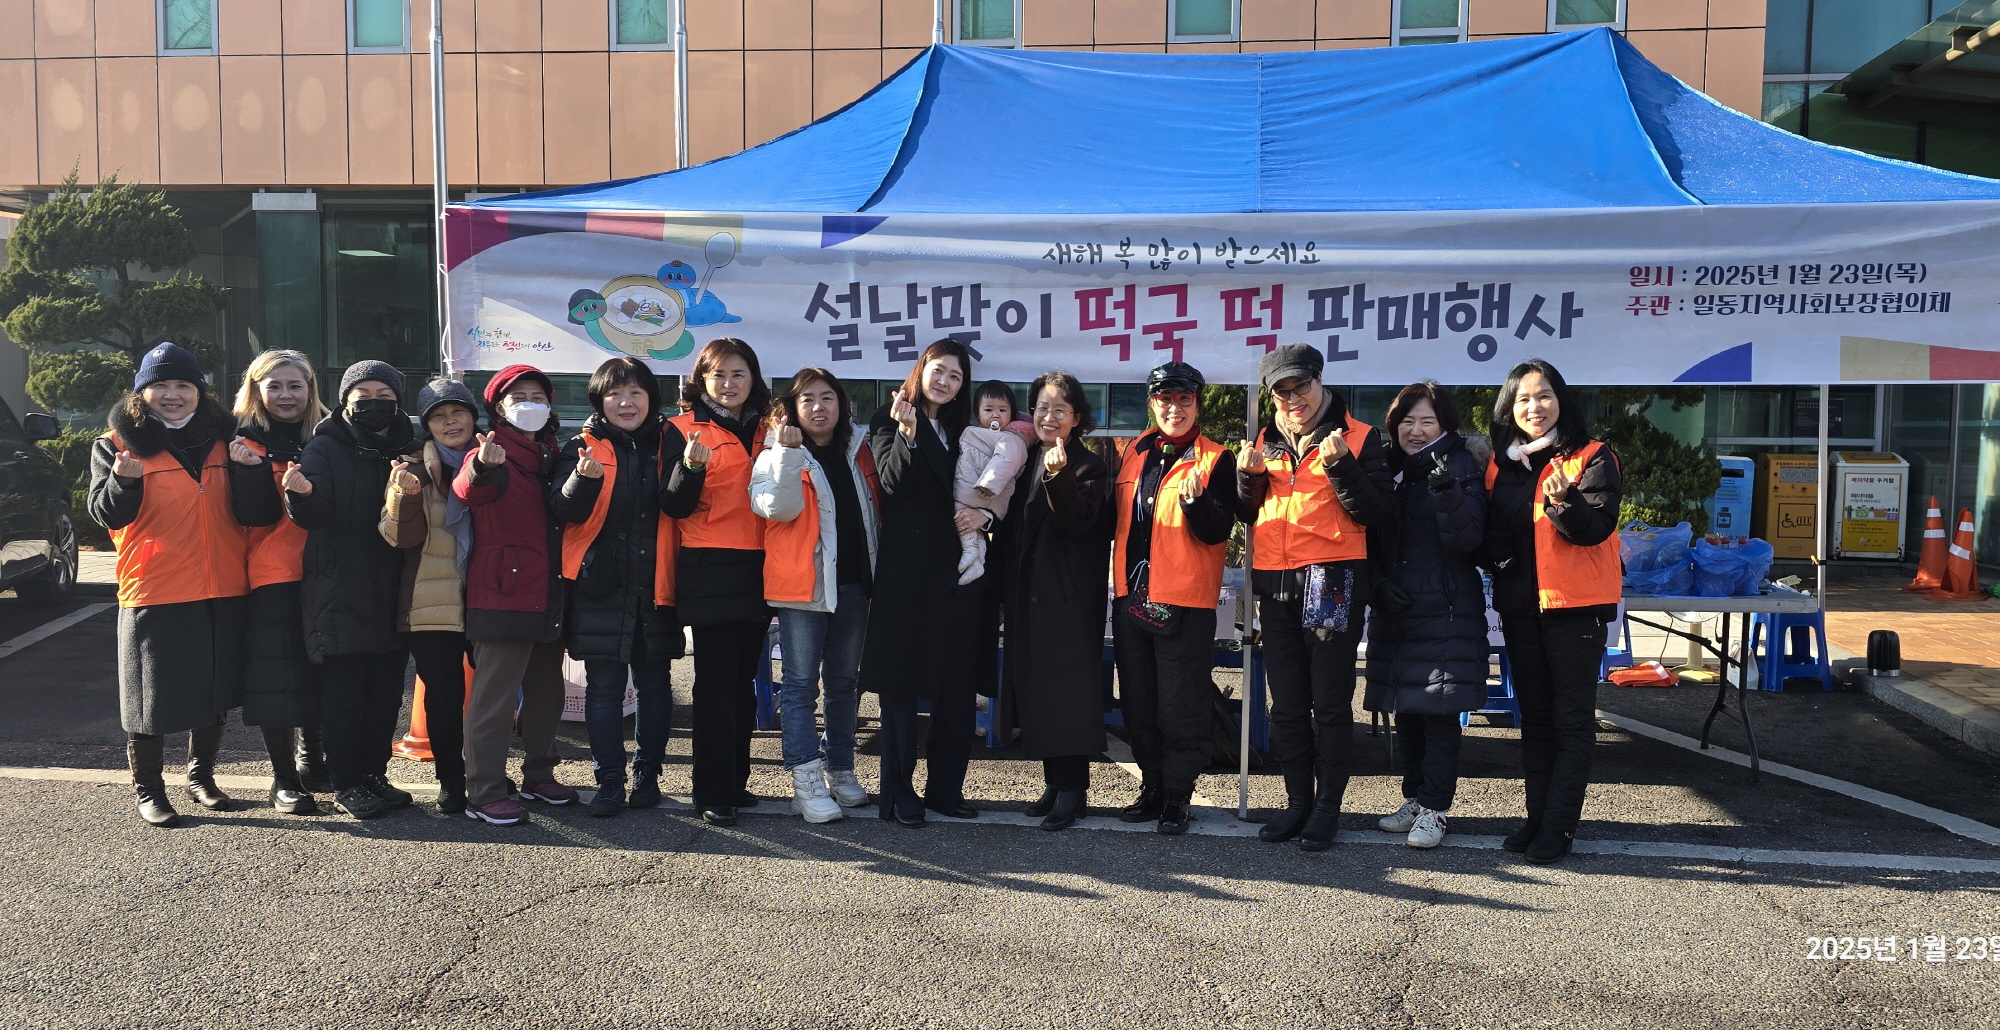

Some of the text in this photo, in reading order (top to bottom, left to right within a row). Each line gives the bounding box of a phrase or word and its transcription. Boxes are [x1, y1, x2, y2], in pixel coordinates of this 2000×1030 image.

[1042, 237, 1321, 271] 새해 복 많이 받으세요
[1629, 265, 1674, 287] 일시
[1694, 264, 1779, 286] 2025년
[1787, 264, 1821, 286] 1월
[1828, 262, 1928, 286] 23일(목)
[1625, 295, 1672, 317] 주관
[1692, 291, 1952, 316] 일동지역사회보장협의체
[467, 326, 491, 341] 시민과
[804, 281, 1584, 363] 설날맞이 떡국 떡 판매행사
[532, 341, 555, 352] 안산
[631, 338, 655, 355] 福
